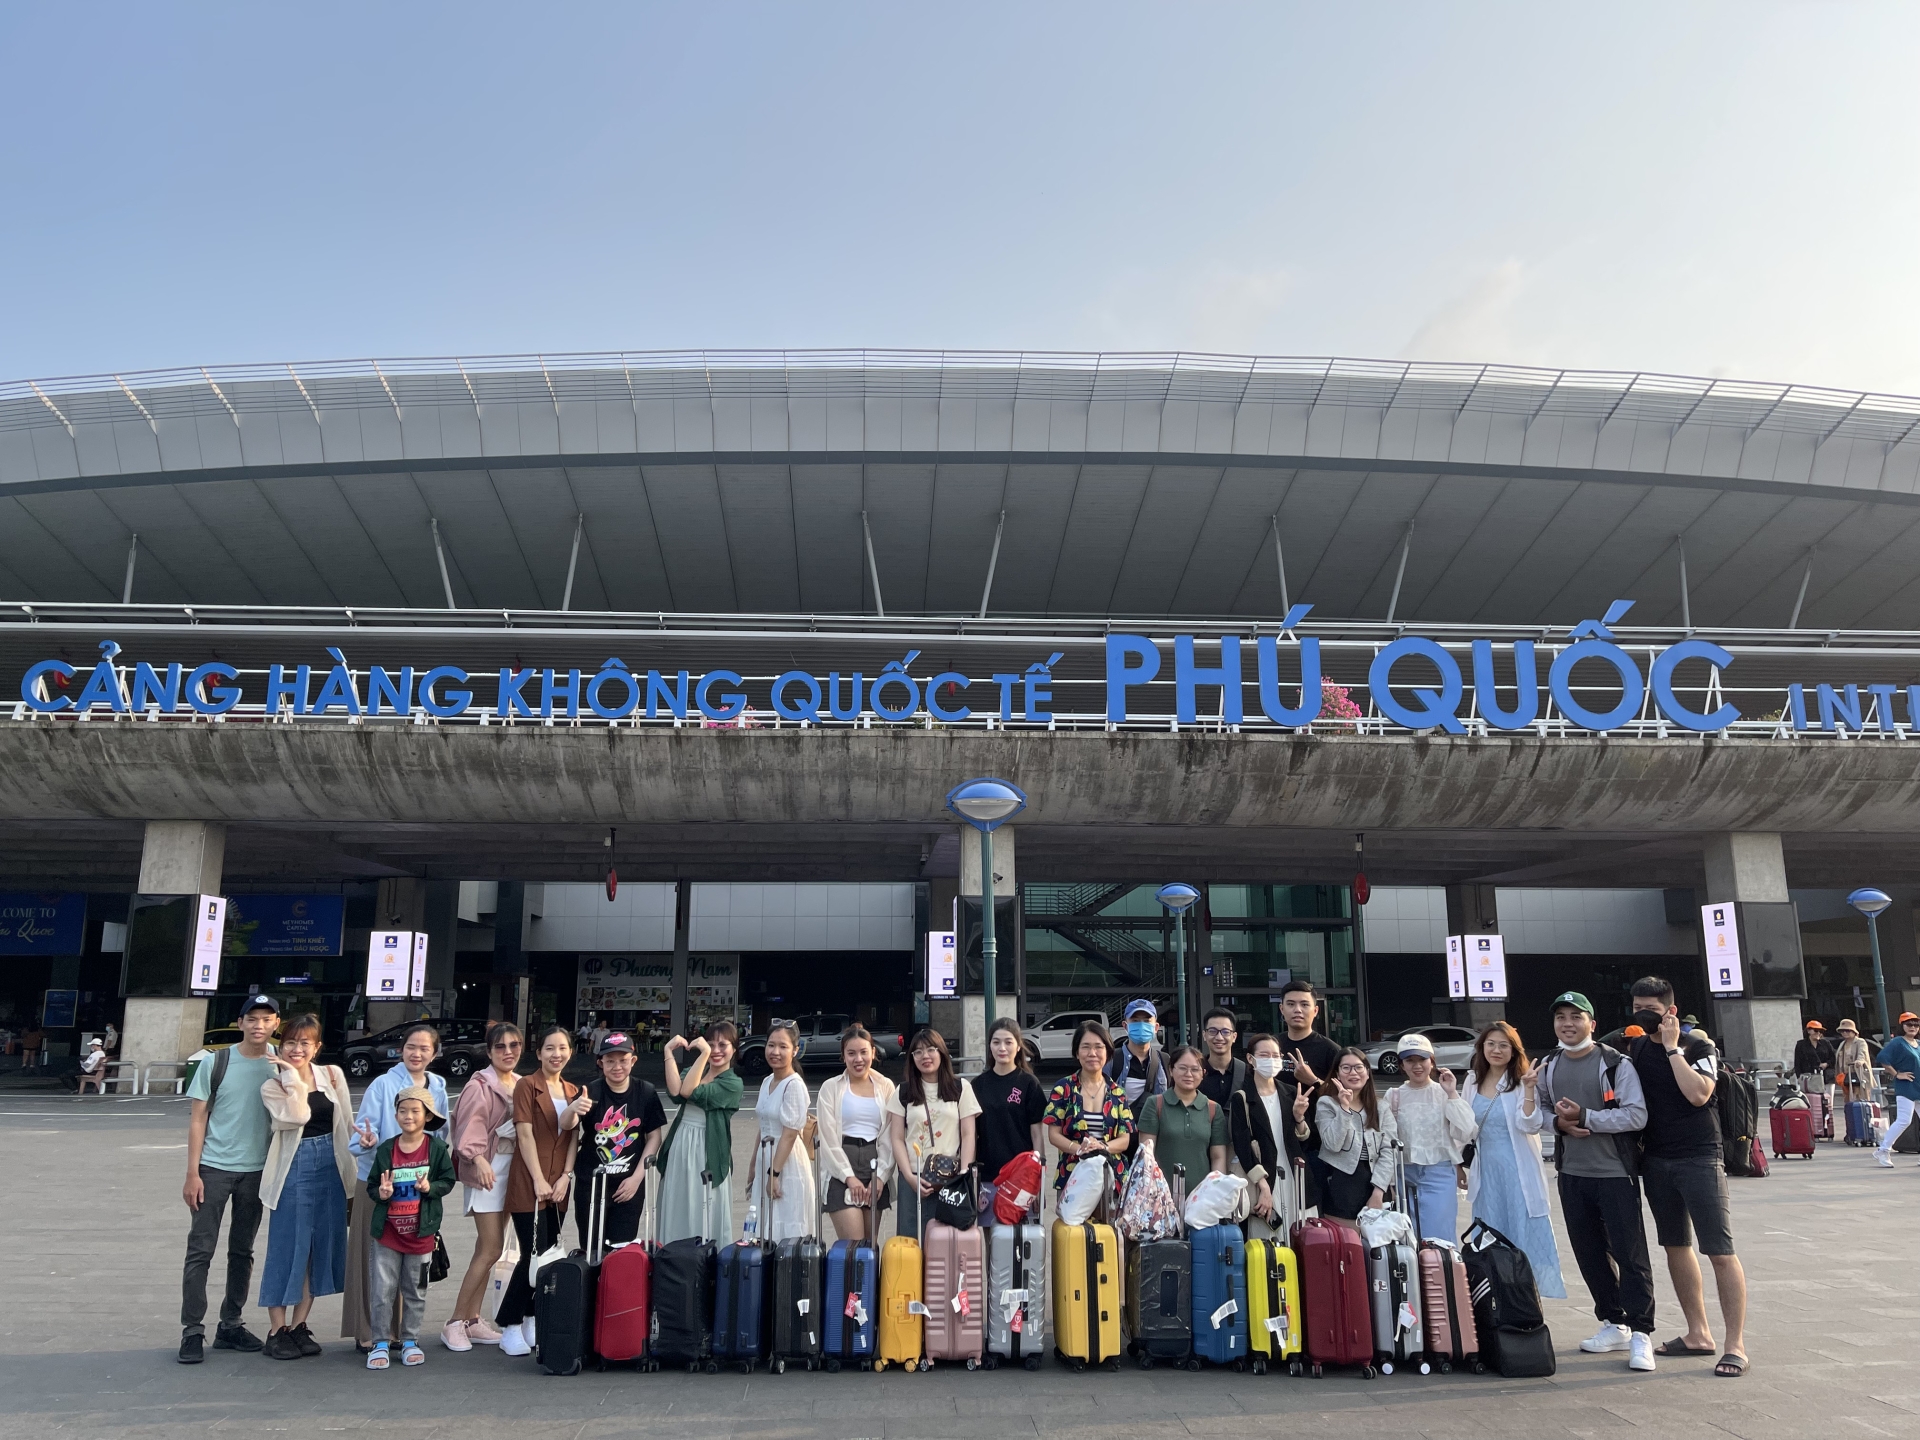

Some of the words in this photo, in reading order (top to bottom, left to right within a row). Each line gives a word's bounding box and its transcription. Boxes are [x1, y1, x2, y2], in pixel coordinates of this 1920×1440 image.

[20, 640, 243, 715] CẢNG
[266, 646, 473, 717] HÀNG
[498, 657, 747, 721] KHÔNG
[771, 650, 972, 723] QUỐC
[992, 652, 1063, 722] TẾ
[1106, 604, 1322, 728] PHÚ
[1369, 600, 1741, 735] QUỐC
[1, 907, 36, 919] COME
[40, 907, 56, 919] TO
[687, 957, 732, 979] Nam
